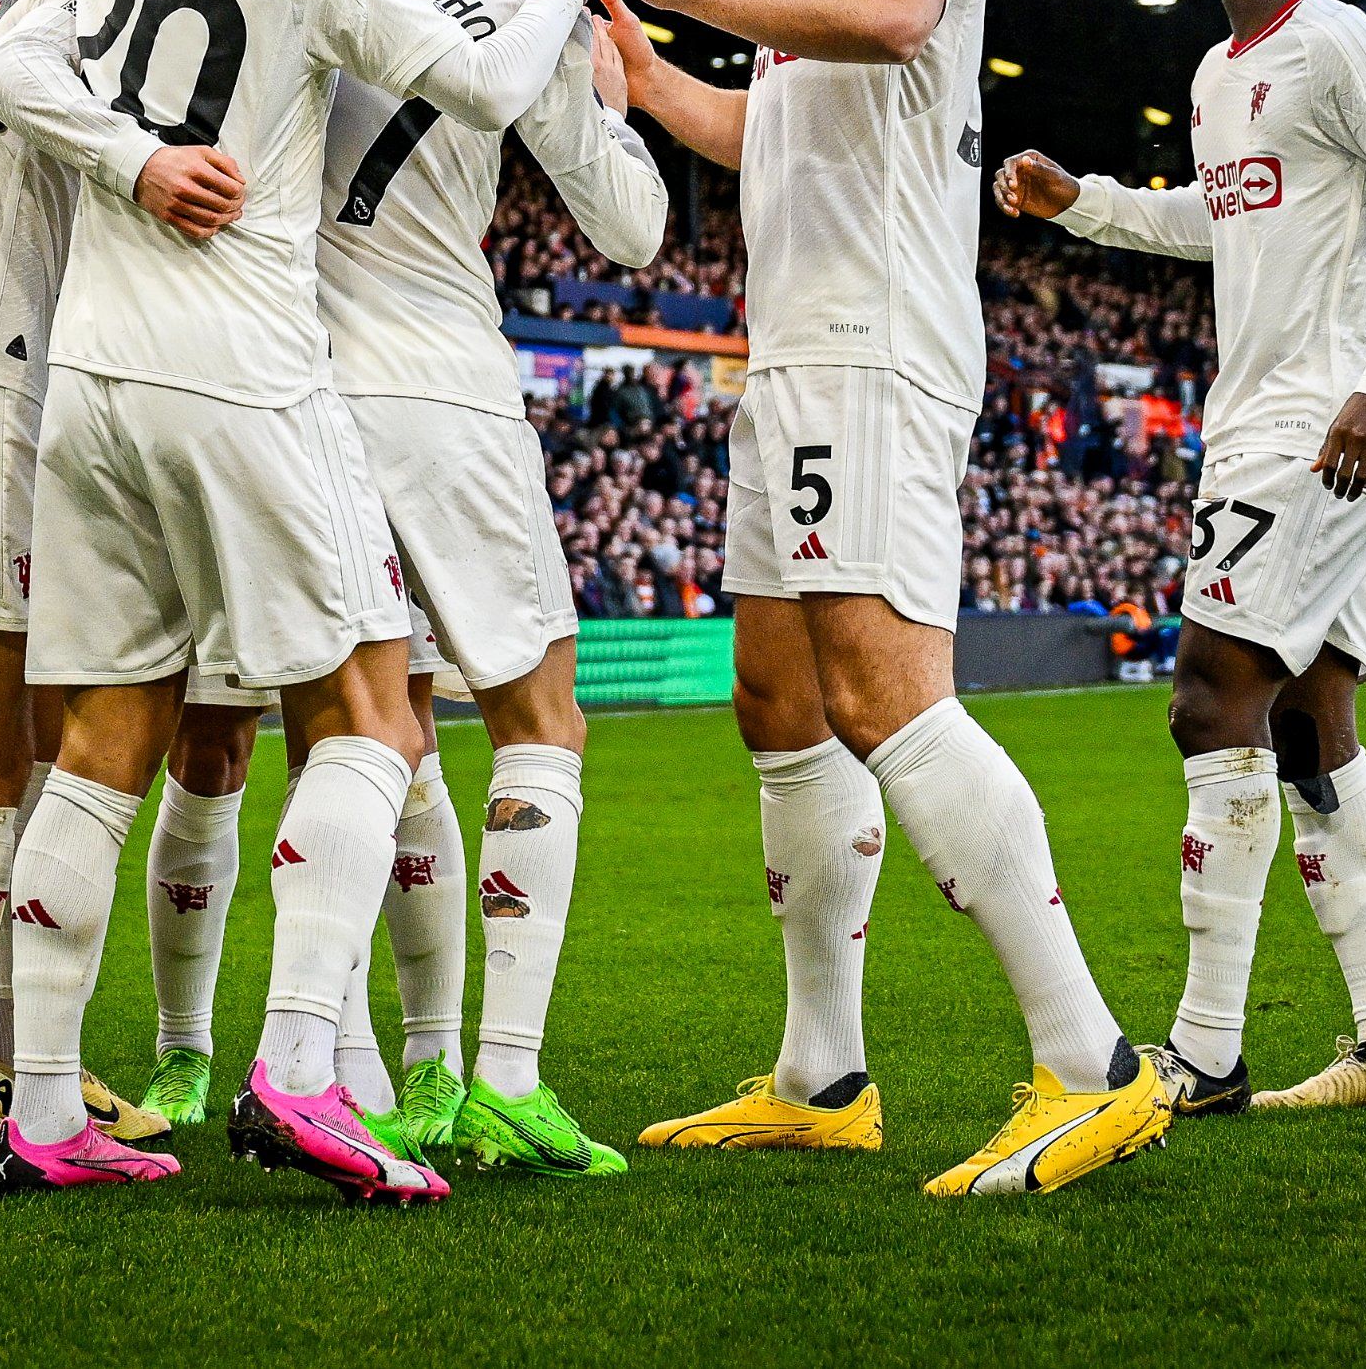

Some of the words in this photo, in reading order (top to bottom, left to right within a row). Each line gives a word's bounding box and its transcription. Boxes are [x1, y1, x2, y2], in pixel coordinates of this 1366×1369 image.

[1197, 161, 1238, 193] Team
[790, 444, 833, 526] 5
[1190, 497, 1277, 573] 37
